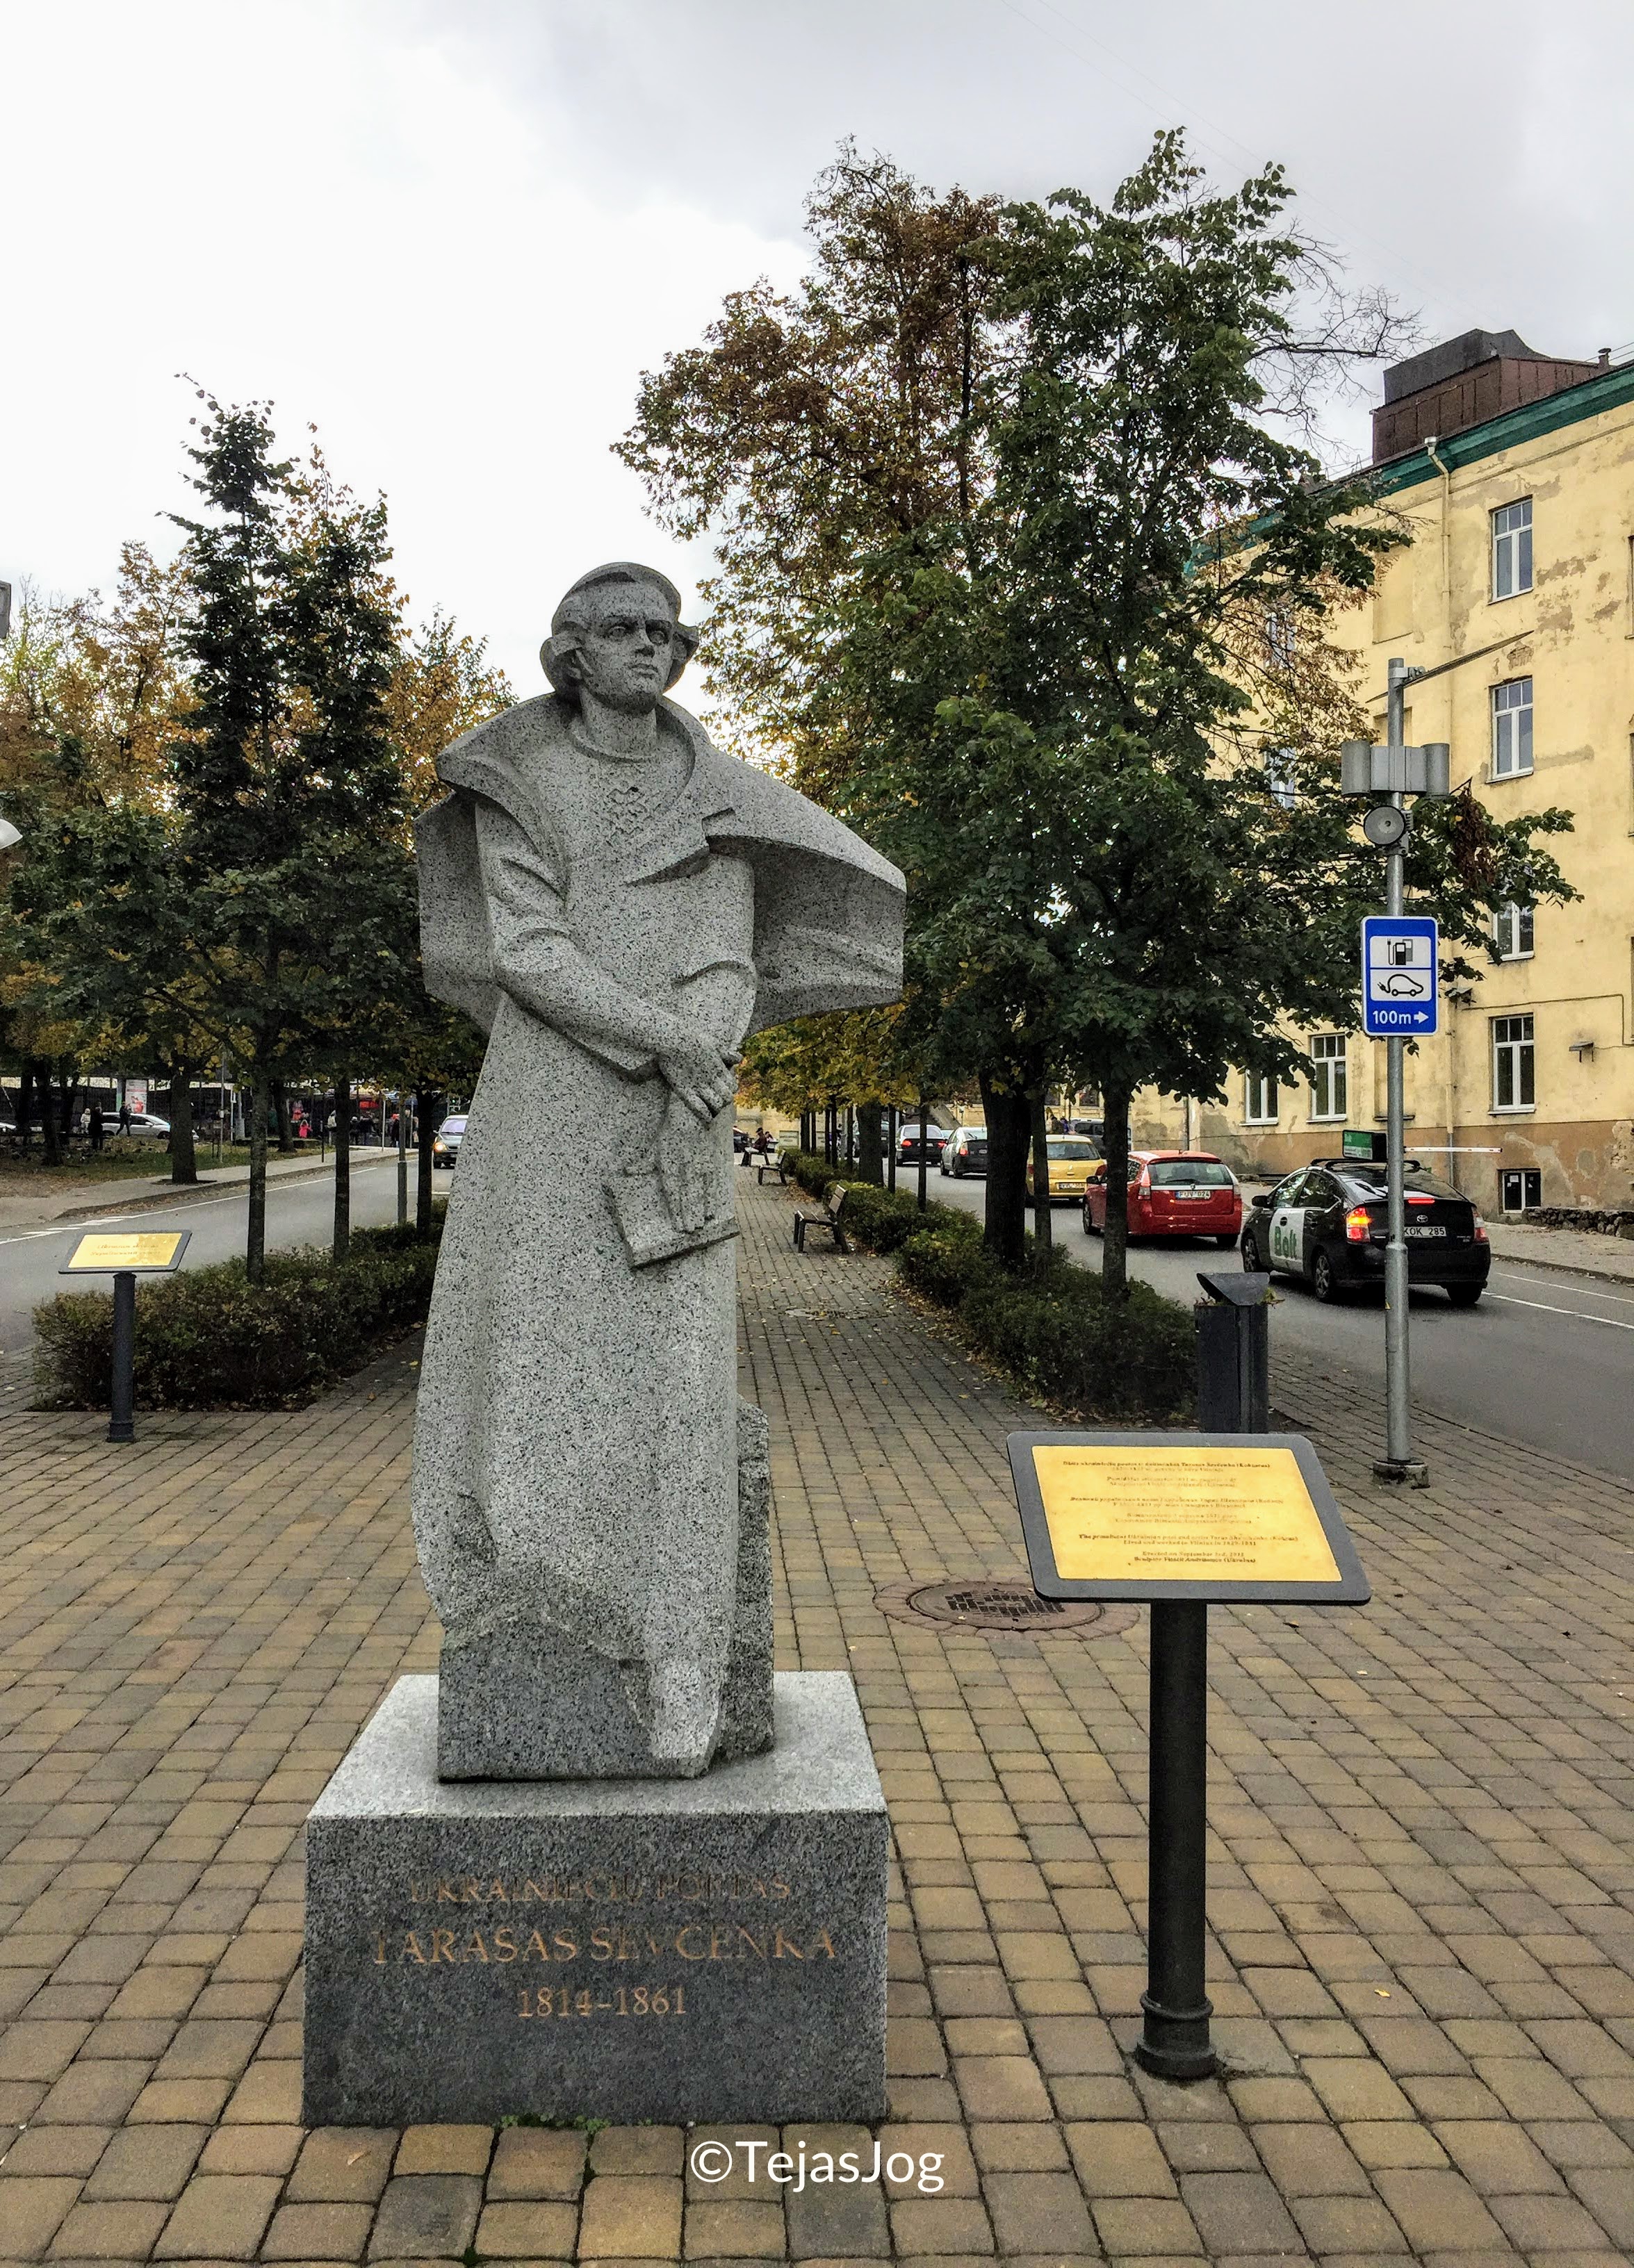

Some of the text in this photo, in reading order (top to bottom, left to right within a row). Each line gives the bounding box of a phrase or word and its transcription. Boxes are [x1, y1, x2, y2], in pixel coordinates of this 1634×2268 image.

[1373, 1010, 1411, 1024] 100m
[1274, 1226, 1297, 1259] Bolt
[1428, 1227, 1445, 1235] 285
[371, 1927, 577, 1964] TARASAS
